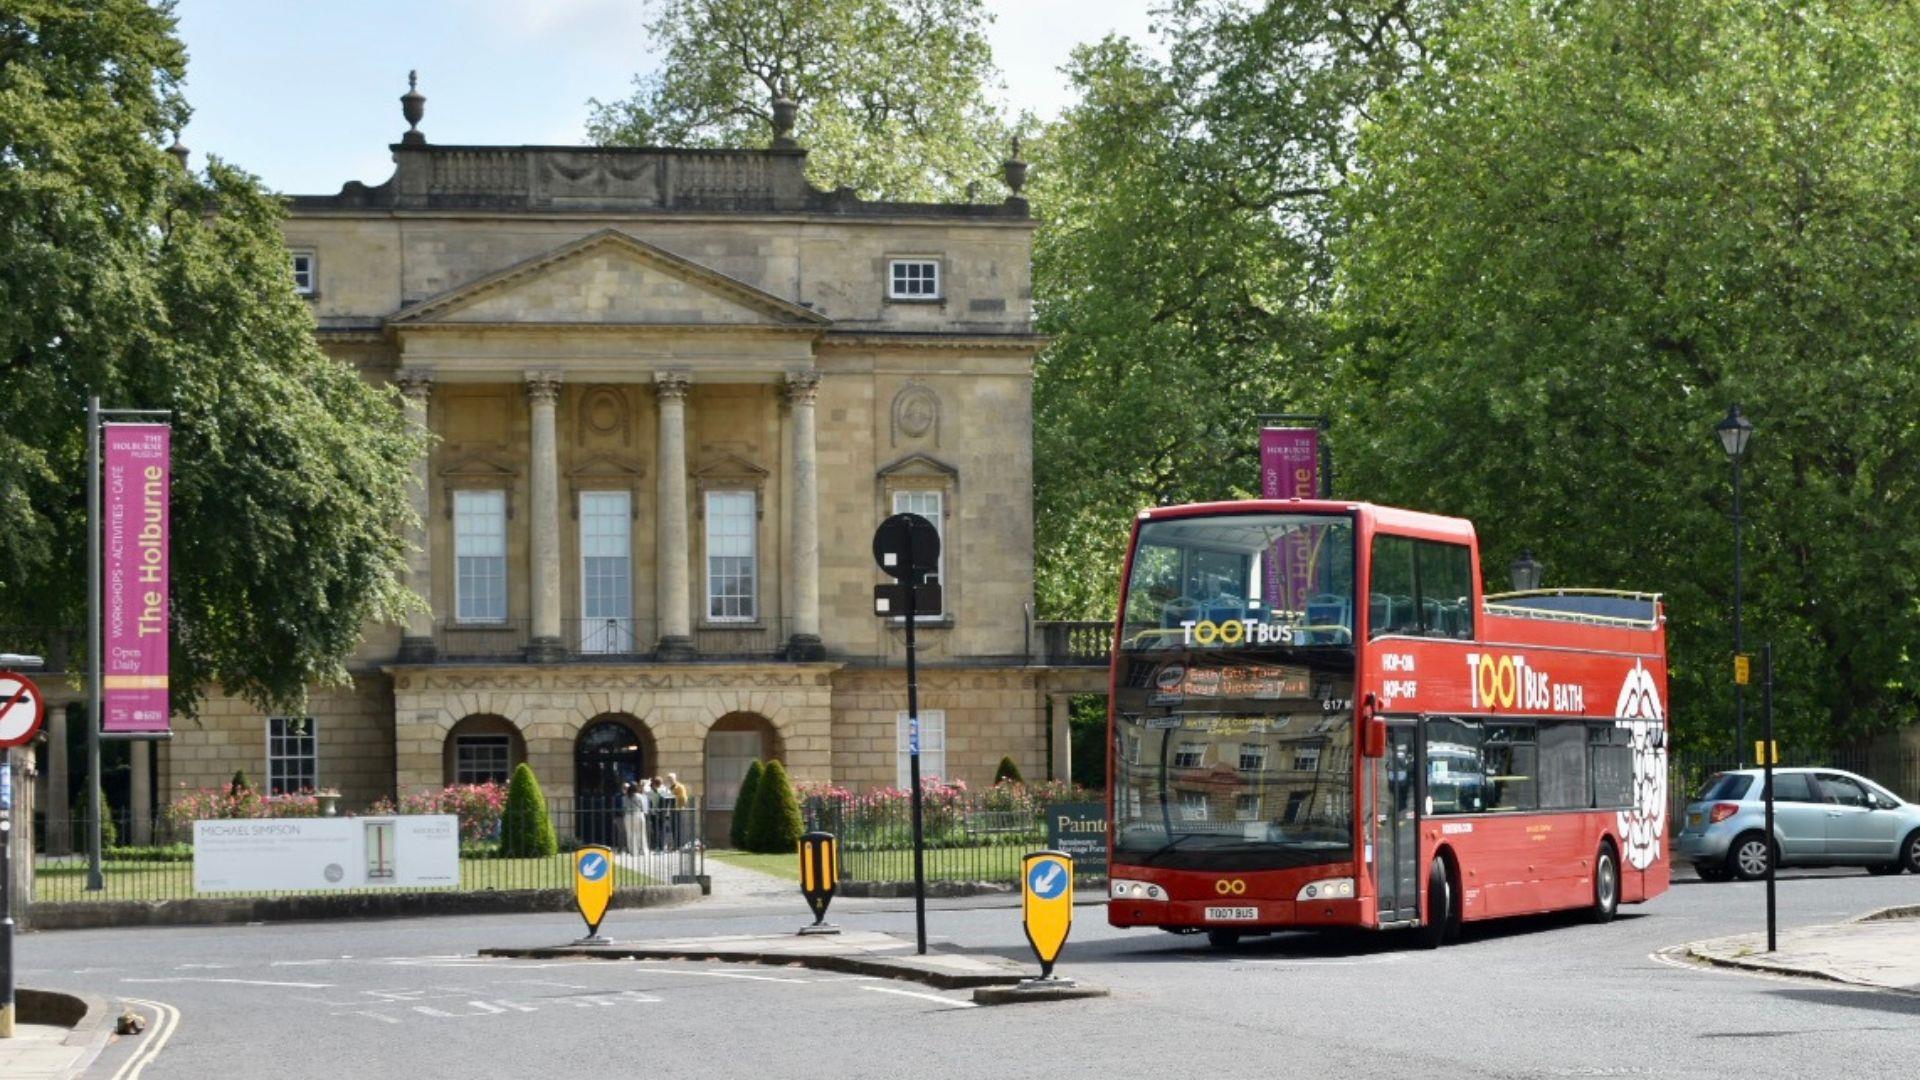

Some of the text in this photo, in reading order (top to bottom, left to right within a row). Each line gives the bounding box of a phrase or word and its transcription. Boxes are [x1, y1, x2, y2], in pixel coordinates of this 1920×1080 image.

[112, 504, 124, 559] ACTIVITIES
[138, 465, 162, 638] The Holburne
[112, 569, 124, 638] WORKSHOPS
[112, 647, 141, 660] Open
[112, 660, 141, 673] Daily
[1323, 699, 1343, 710] 617
[201, 824, 301, 836] MICHAEL SIMPSON
